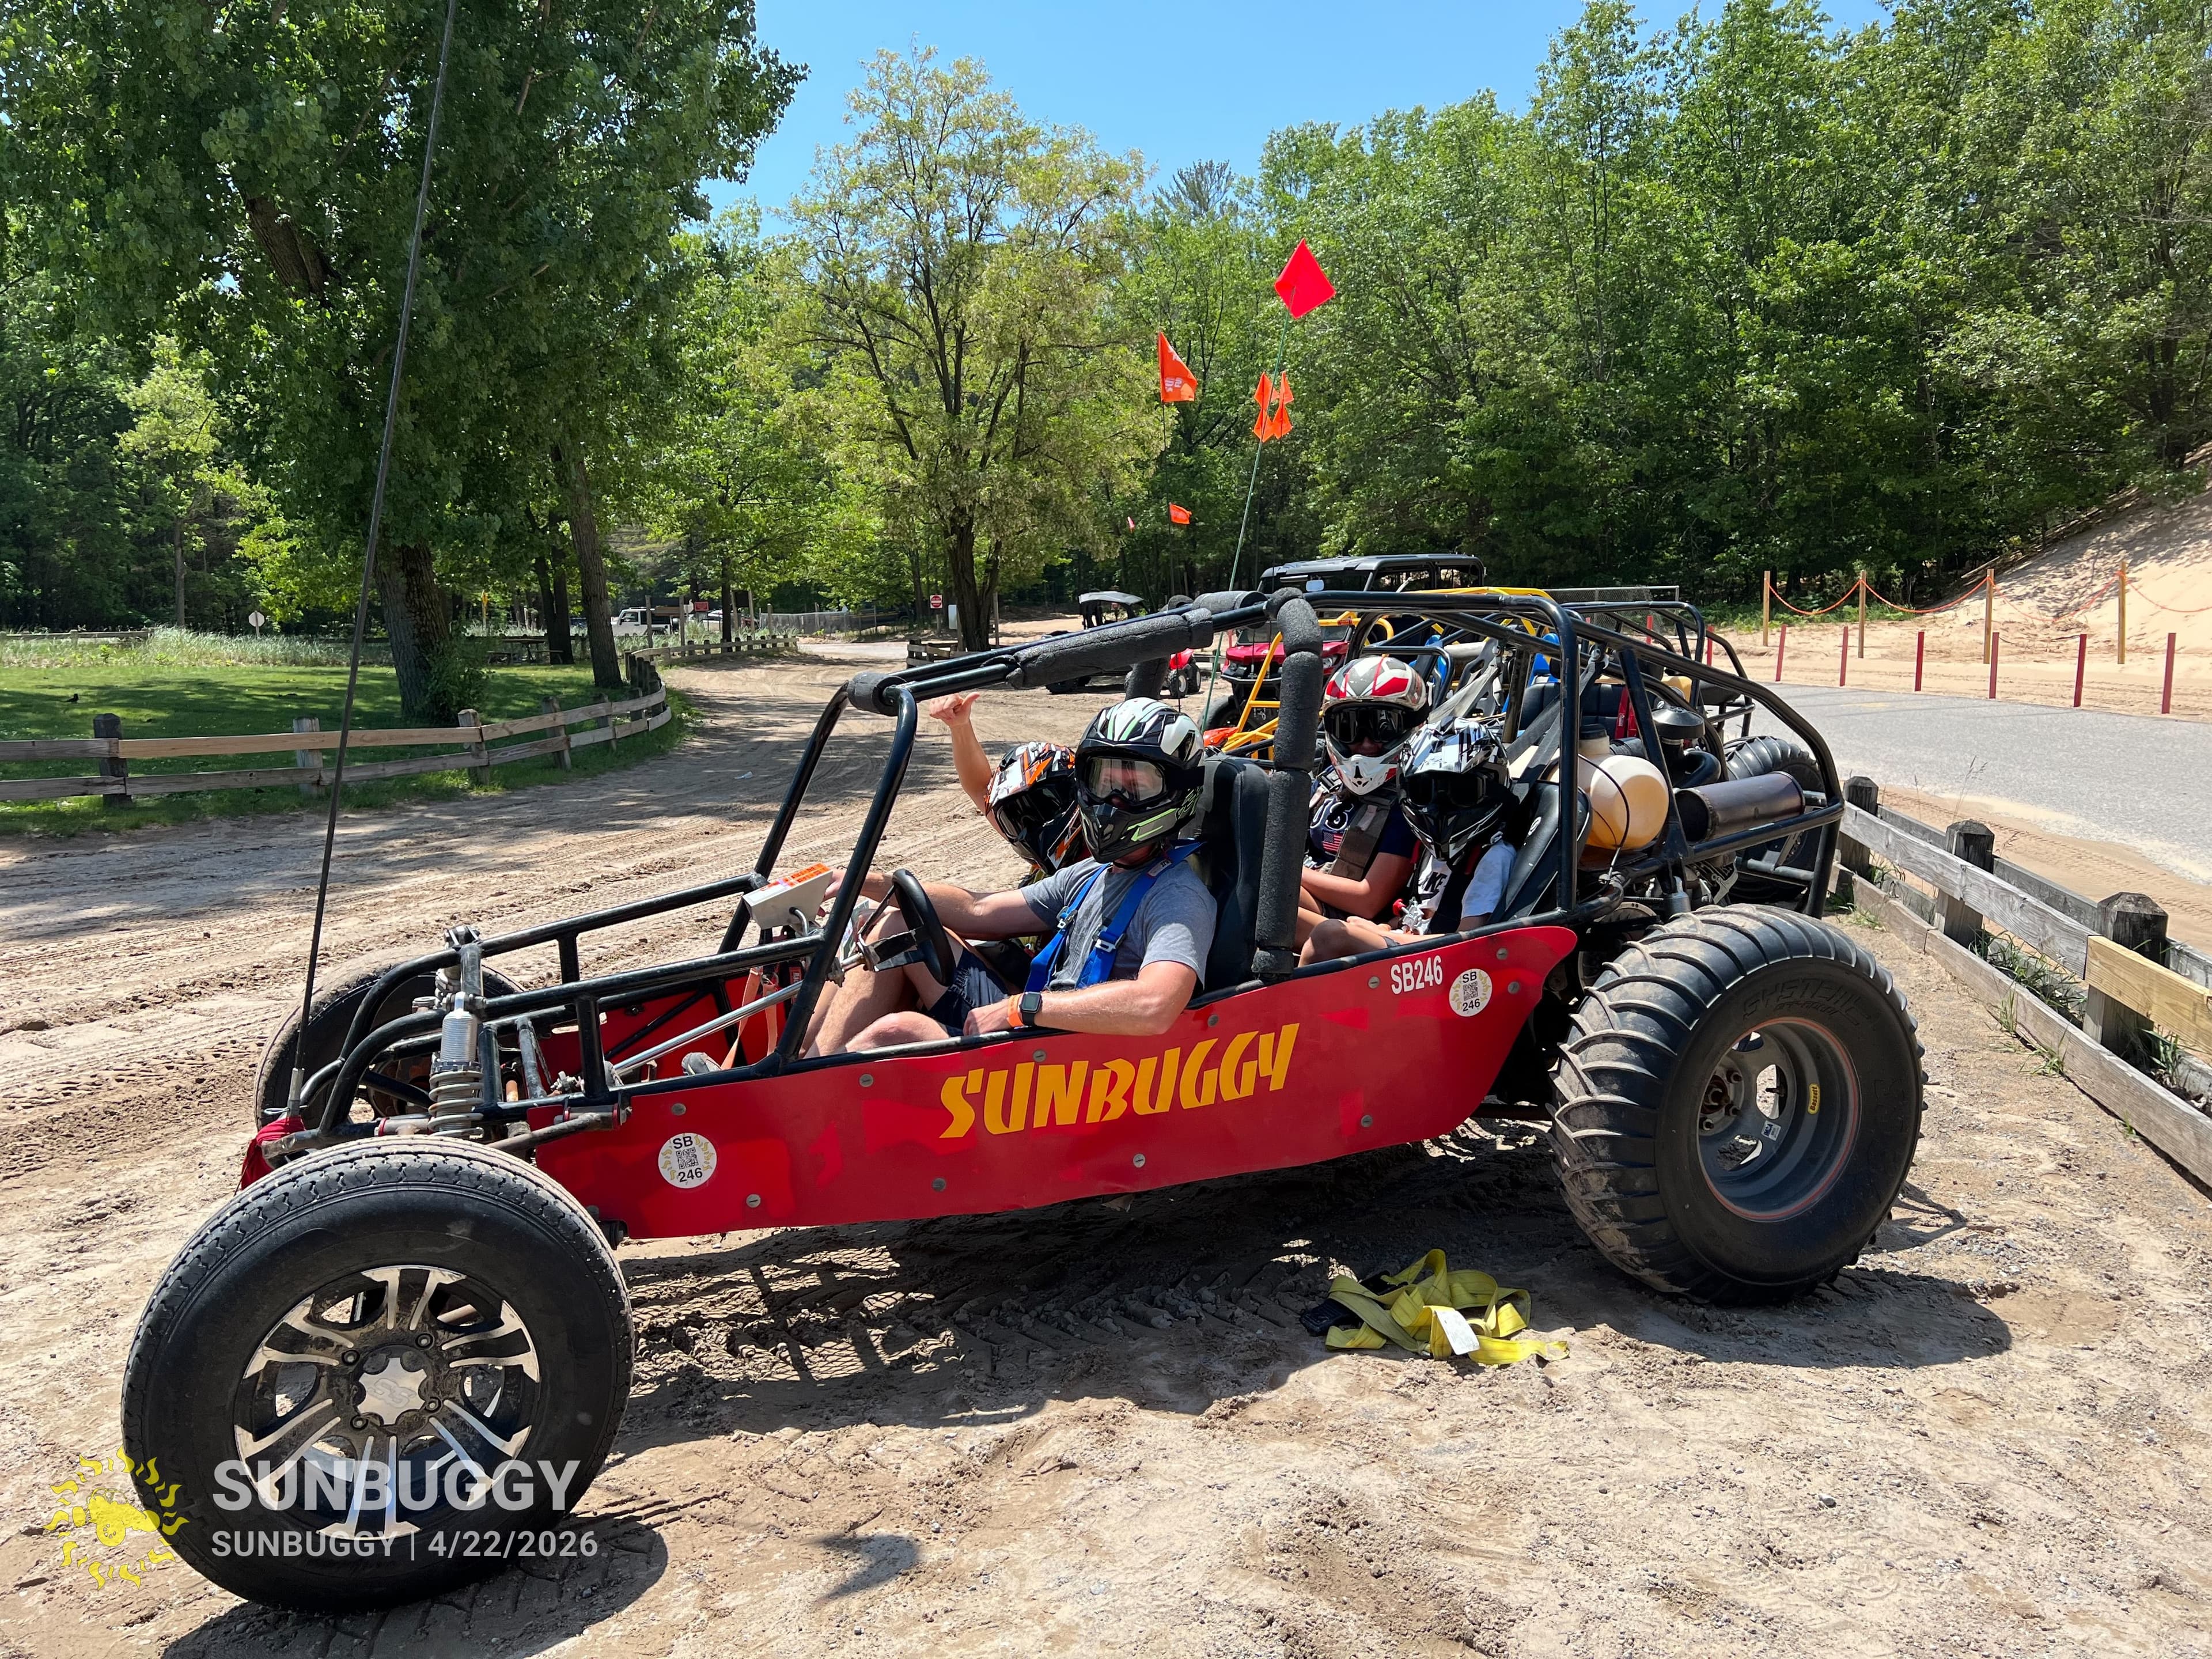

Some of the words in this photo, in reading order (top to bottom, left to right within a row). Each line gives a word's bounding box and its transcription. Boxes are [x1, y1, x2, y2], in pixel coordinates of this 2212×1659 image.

[1391, 955, 1443, 994] SB246
[1463, 971, 1477, 983] SB
[1463, 998, 1480, 1012] 246
[939, 1022, 1300, 1138] SUNBUGGY
[673, 1136, 694, 1149] SB
[678, 1168, 703, 1183] 246
